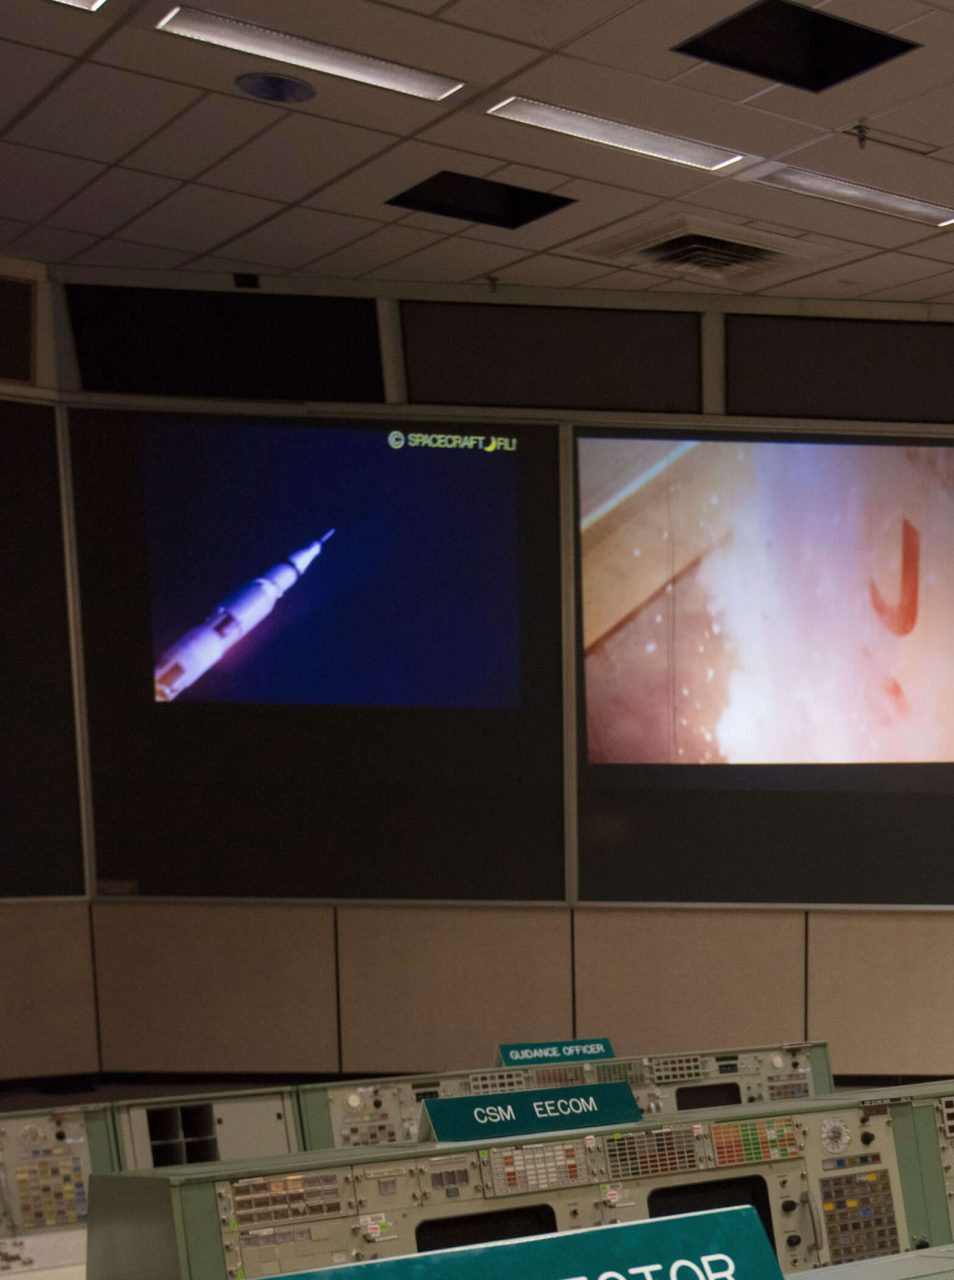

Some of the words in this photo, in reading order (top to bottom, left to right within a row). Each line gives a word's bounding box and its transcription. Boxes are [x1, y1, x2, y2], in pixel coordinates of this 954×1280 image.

[509, 1046, 560, 1061] GUIDANCE
[562, 1043, 606, 1056] OFFICER
[473, 1105, 516, 1124] CSM
[533, 1096, 598, 1118] EECOM
